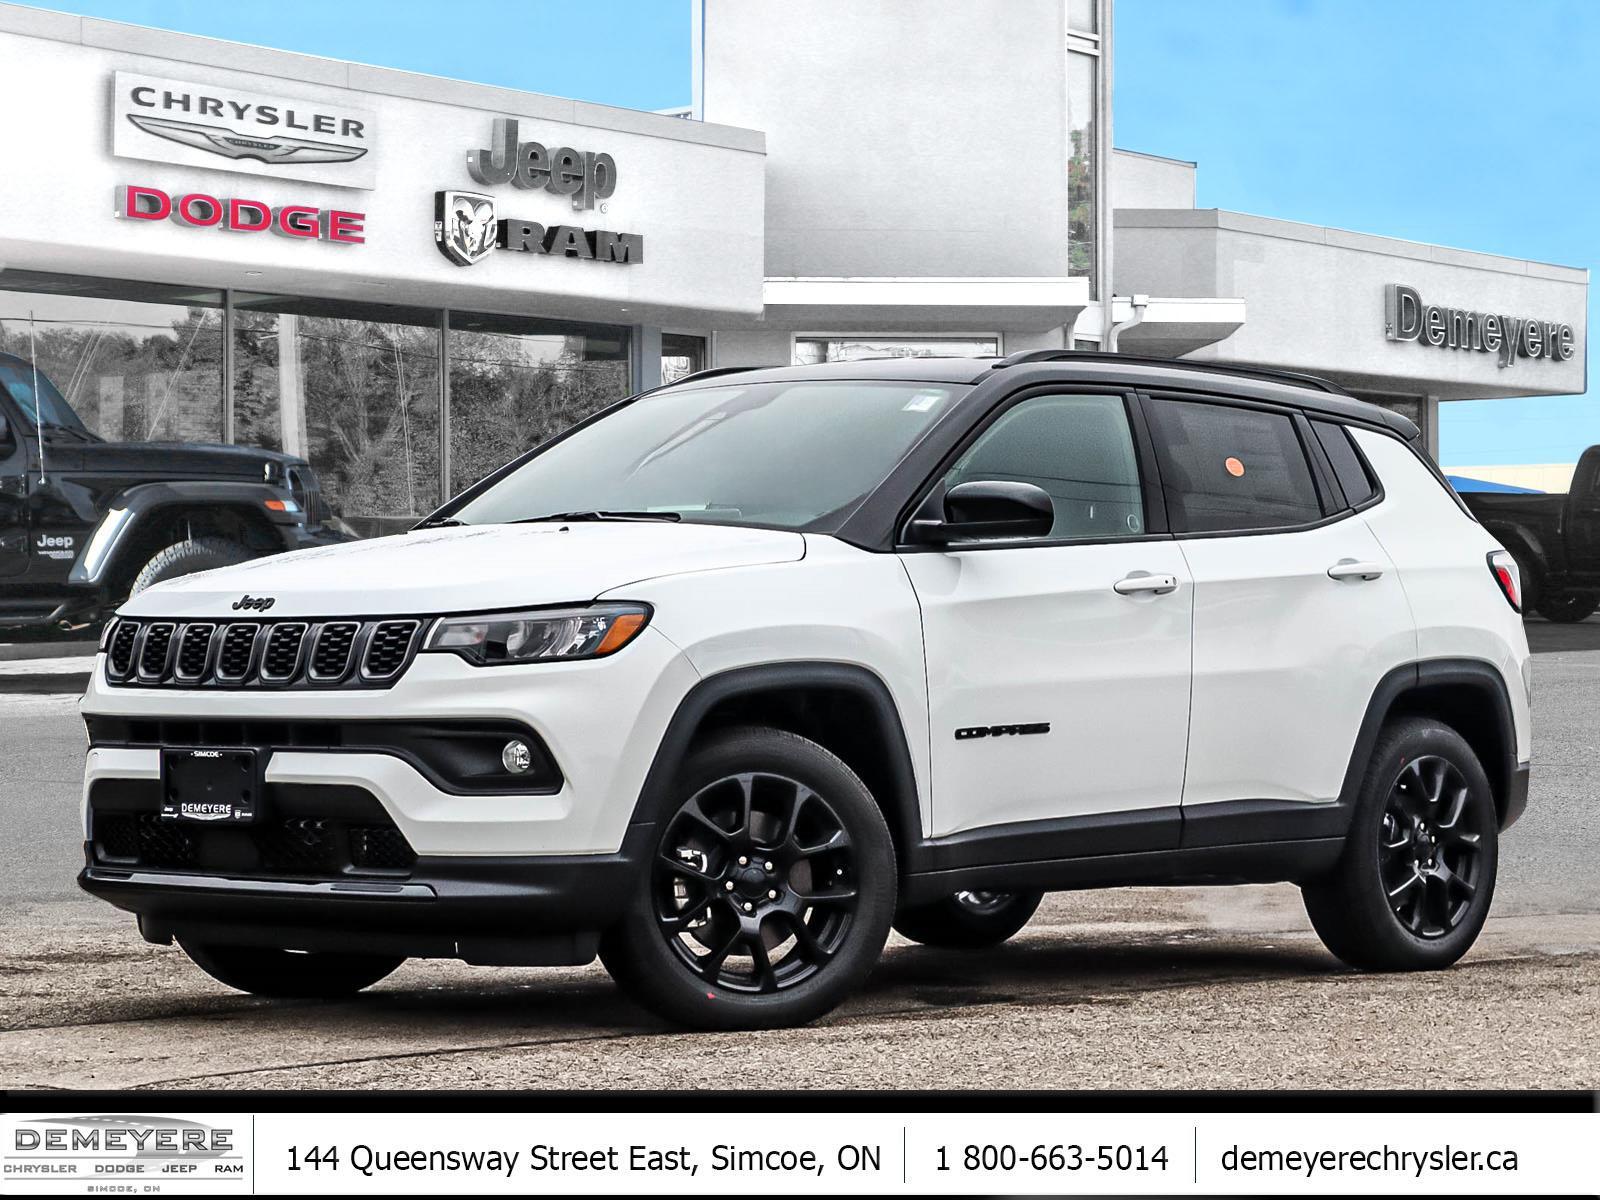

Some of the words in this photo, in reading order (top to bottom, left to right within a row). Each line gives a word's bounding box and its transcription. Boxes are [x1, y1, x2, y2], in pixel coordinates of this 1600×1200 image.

[130, 86, 365, 138] CHRYSLER
[467, 118, 617, 210] Jeep
[116, 184, 366, 243] DODGE
[496, 218, 643, 264] RAM
[1385, 284, 1575, 367] Demeyere
[37, 534, 73, 548] Jeep
[231, 594, 276, 613] Jeep
[181, 803, 232, 813] DEMEYERE
